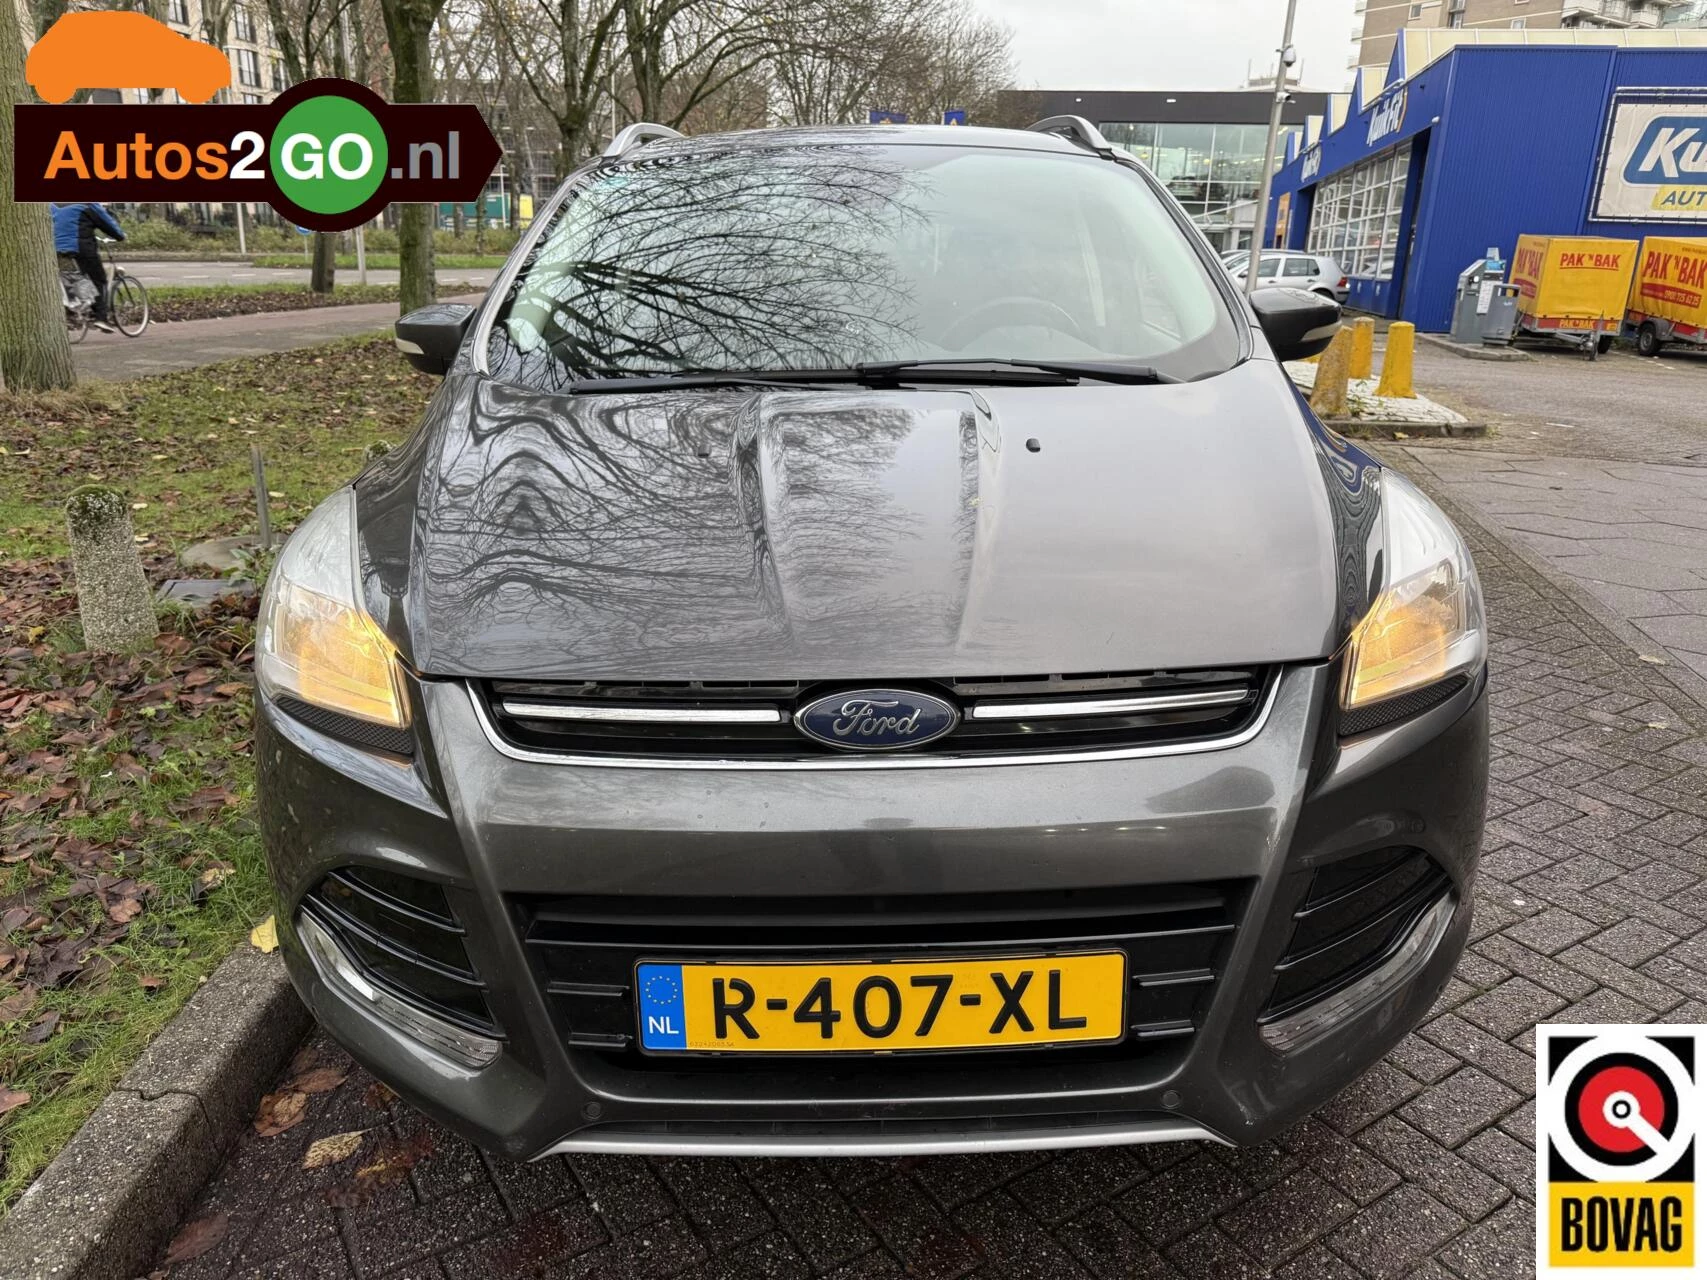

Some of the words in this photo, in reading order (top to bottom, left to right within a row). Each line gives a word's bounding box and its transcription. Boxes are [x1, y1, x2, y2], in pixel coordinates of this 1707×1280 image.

[1560, 253, 1586, 268] PAK
[1594, 254, 1621, 269] BAK
[1642, 250, 1673, 280] PAK
[1678, 256, 1707, 290] BAK
[832, 699, 921, 736] Ford
[711, 969, 1088, 1040] R-407-XL
[648, 1016, 680, 1036] NL
